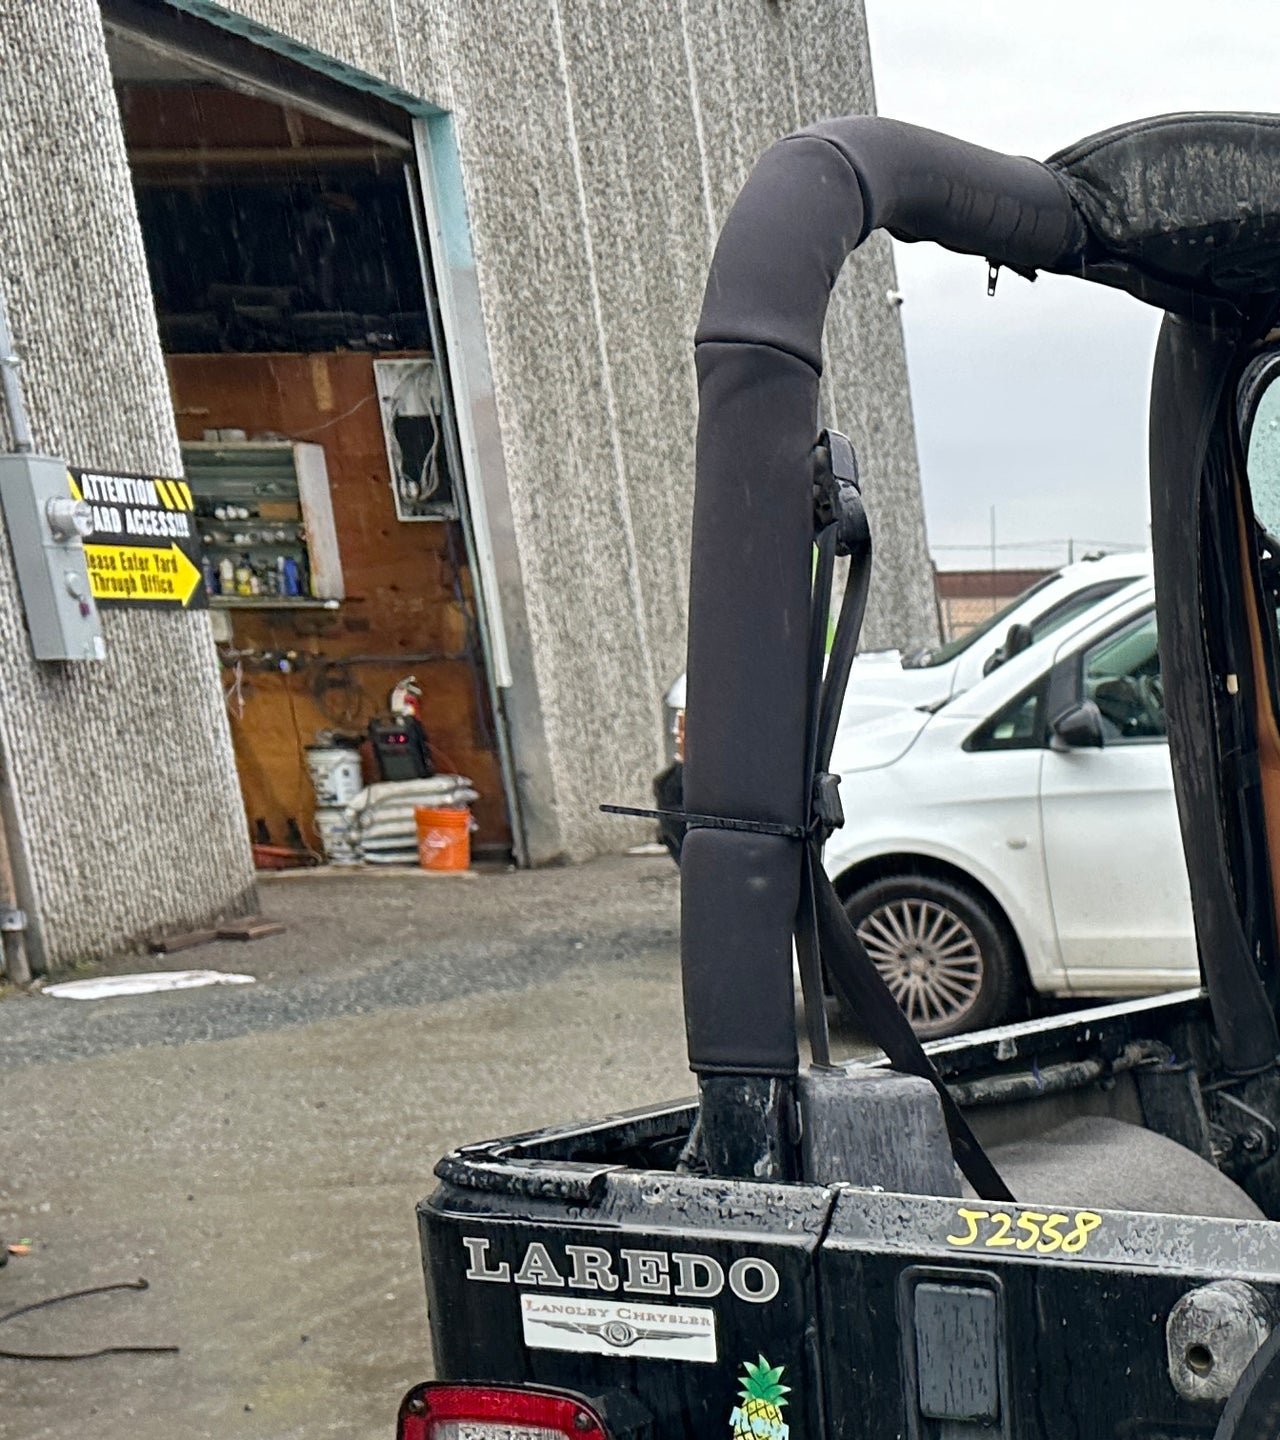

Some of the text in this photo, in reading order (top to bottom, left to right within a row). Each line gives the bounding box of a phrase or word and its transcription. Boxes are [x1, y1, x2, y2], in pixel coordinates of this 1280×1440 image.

[81, 473, 159, 506] ATTENTION
[93, 506, 122, 533] ARD
[85, 551, 178, 573] lease Enter Yard
[91, 572, 174, 595] Through Office
[947, 1208, 1102, 1253] J2558
[462, 1236, 780, 1303] LAREDO
[525, 1299, 711, 1327] LANGLEY CHRYSLER
